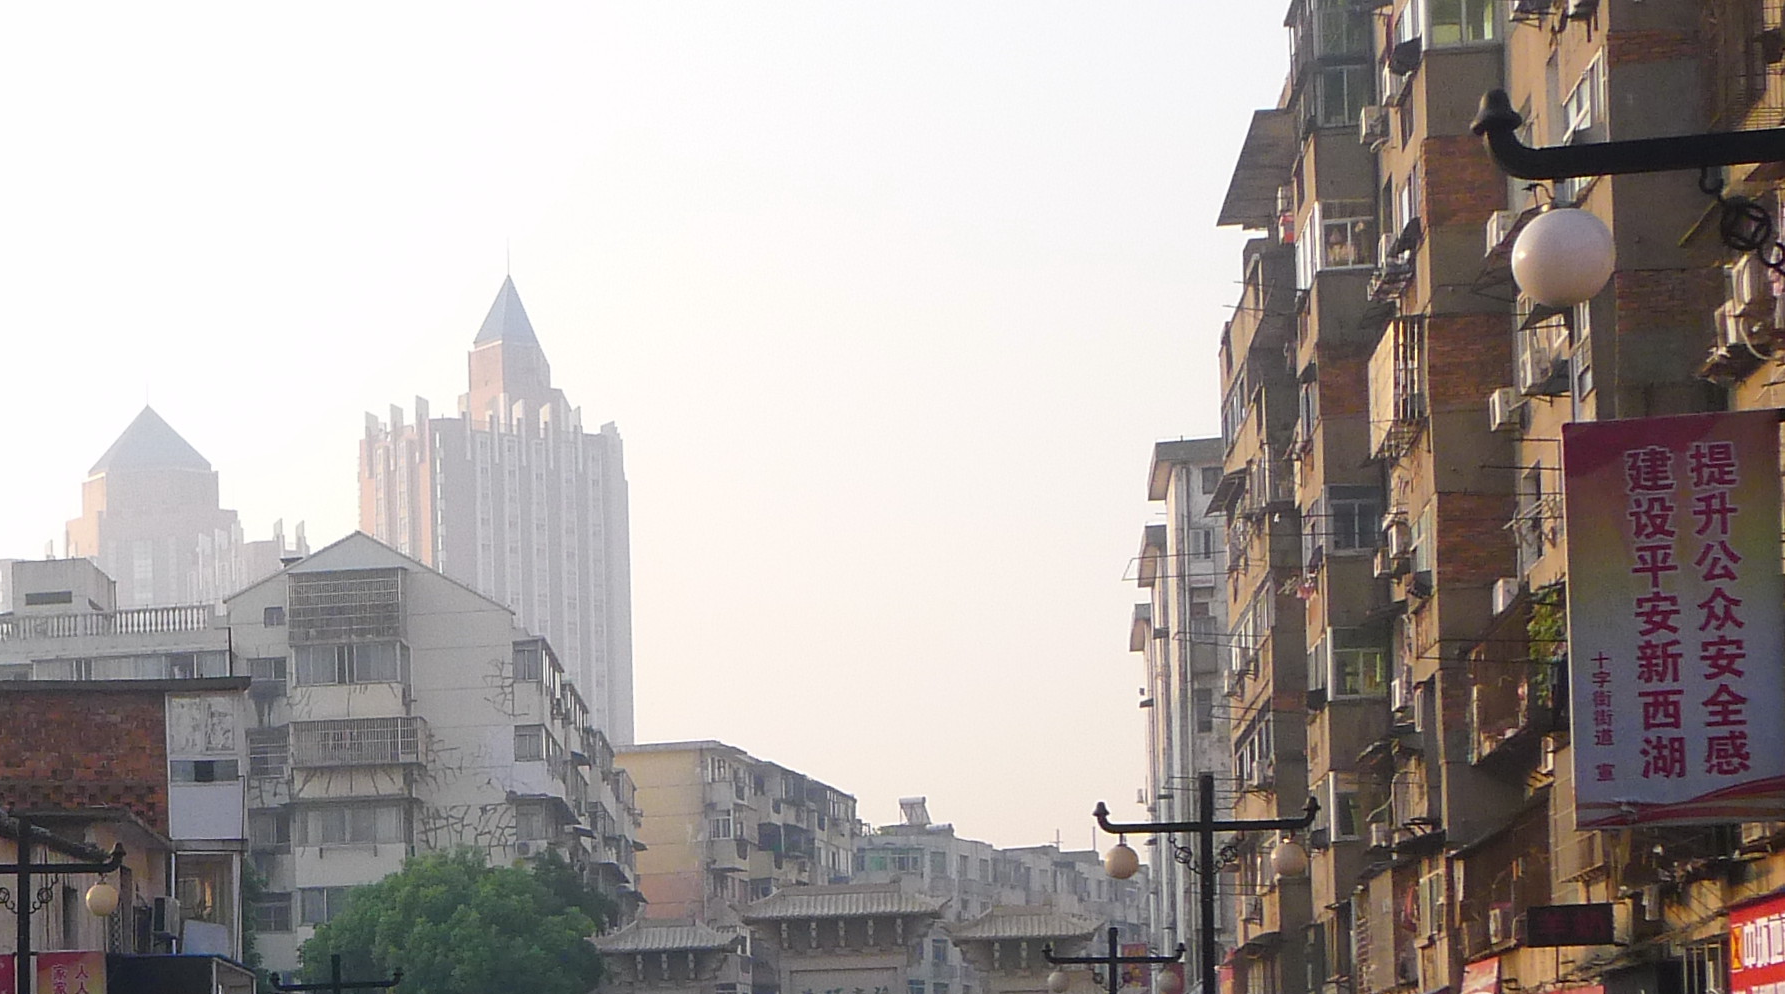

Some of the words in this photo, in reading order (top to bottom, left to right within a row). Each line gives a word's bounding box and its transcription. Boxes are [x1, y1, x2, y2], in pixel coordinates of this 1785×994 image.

[1590, 651, 1615, 747] 十字街街道
[1624, 445, 1689, 780] 建设平安新西湖
[1687, 441, 1752, 777] 提升公众安全感
[1595, 761, 1616, 783] 宣
